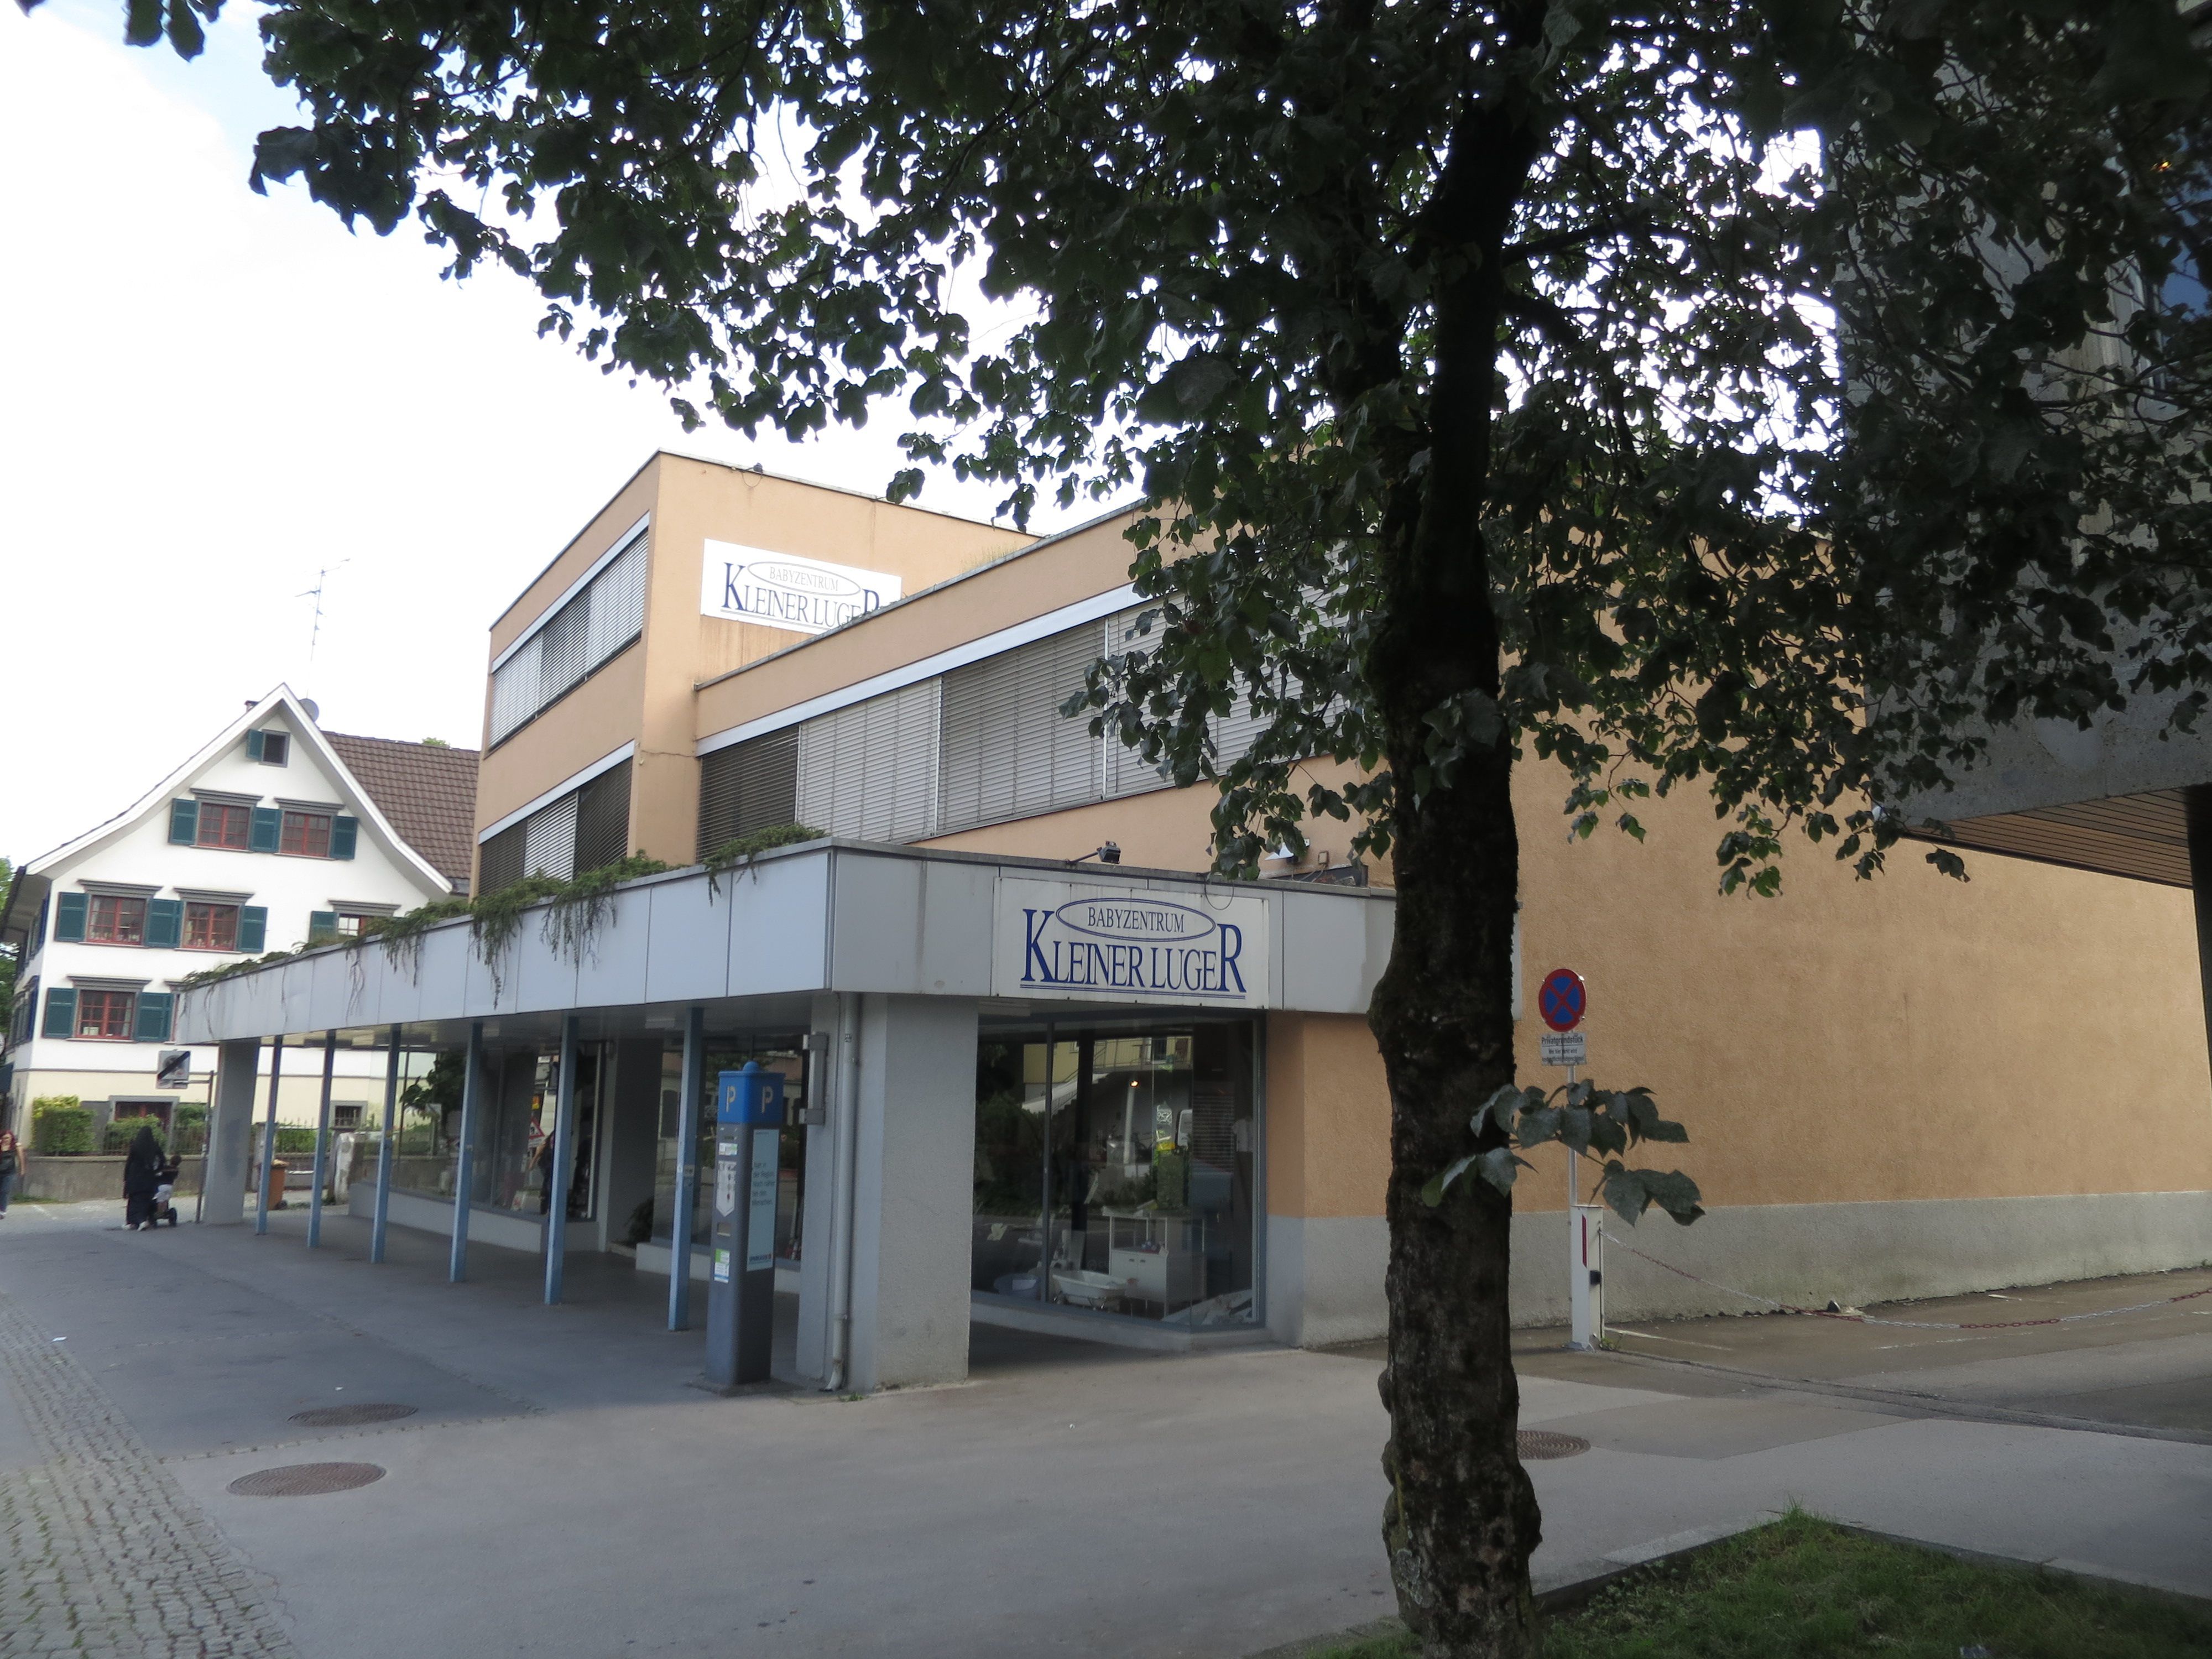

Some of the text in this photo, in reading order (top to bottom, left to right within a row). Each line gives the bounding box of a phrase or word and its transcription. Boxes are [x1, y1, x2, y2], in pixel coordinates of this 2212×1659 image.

[769, 566, 838, 591] BABYZENTRUM
[722, 562, 808, 623] KLEINER
[1088, 907, 1185, 933] BABYZENTRUM
[1021, 909, 1246, 993] KLEINER LUGER
[726, 1086, 736, 1113] P
[761, 1086, 773, 1114] P
